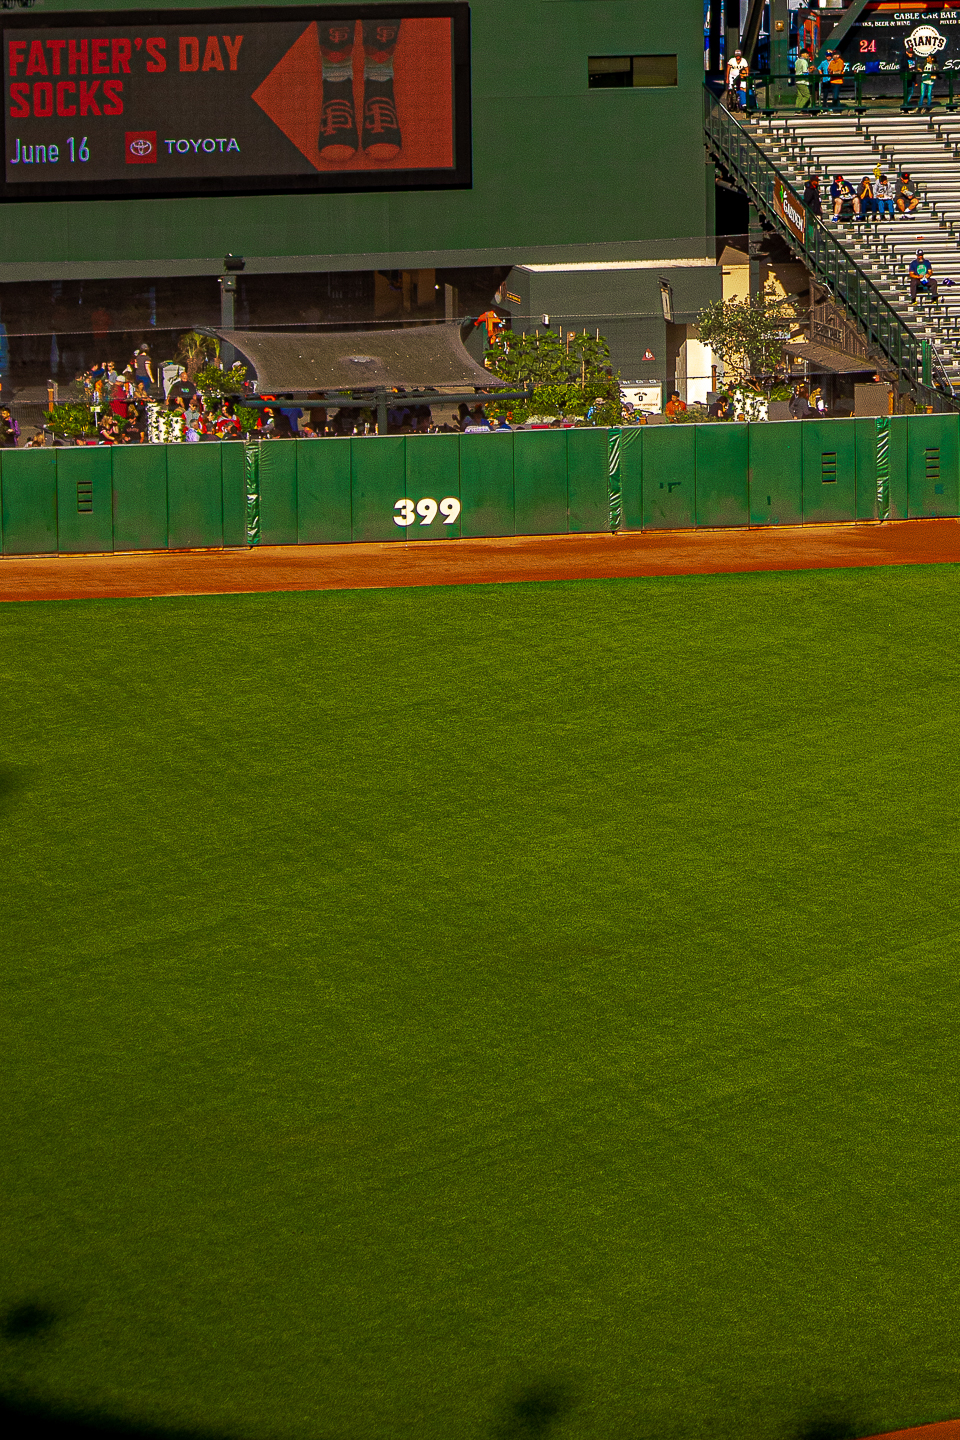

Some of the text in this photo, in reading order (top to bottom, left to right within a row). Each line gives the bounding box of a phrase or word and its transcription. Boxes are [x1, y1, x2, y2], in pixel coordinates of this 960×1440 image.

[894, 12, 920, 20] CABLE
[940, 11, 957, 19] BAR
[860, 40, 876, 52] 24
[906, 35, 945, 49] GIANTS
[8, 35, 244, 77] FATHER'S DAY
[9, 80, 124, 118] SOCKS
[10, 136, 90, 164] June 16
[164, 138, 240, 154] TOYOTA
[393, 497, 462, 527] 399
